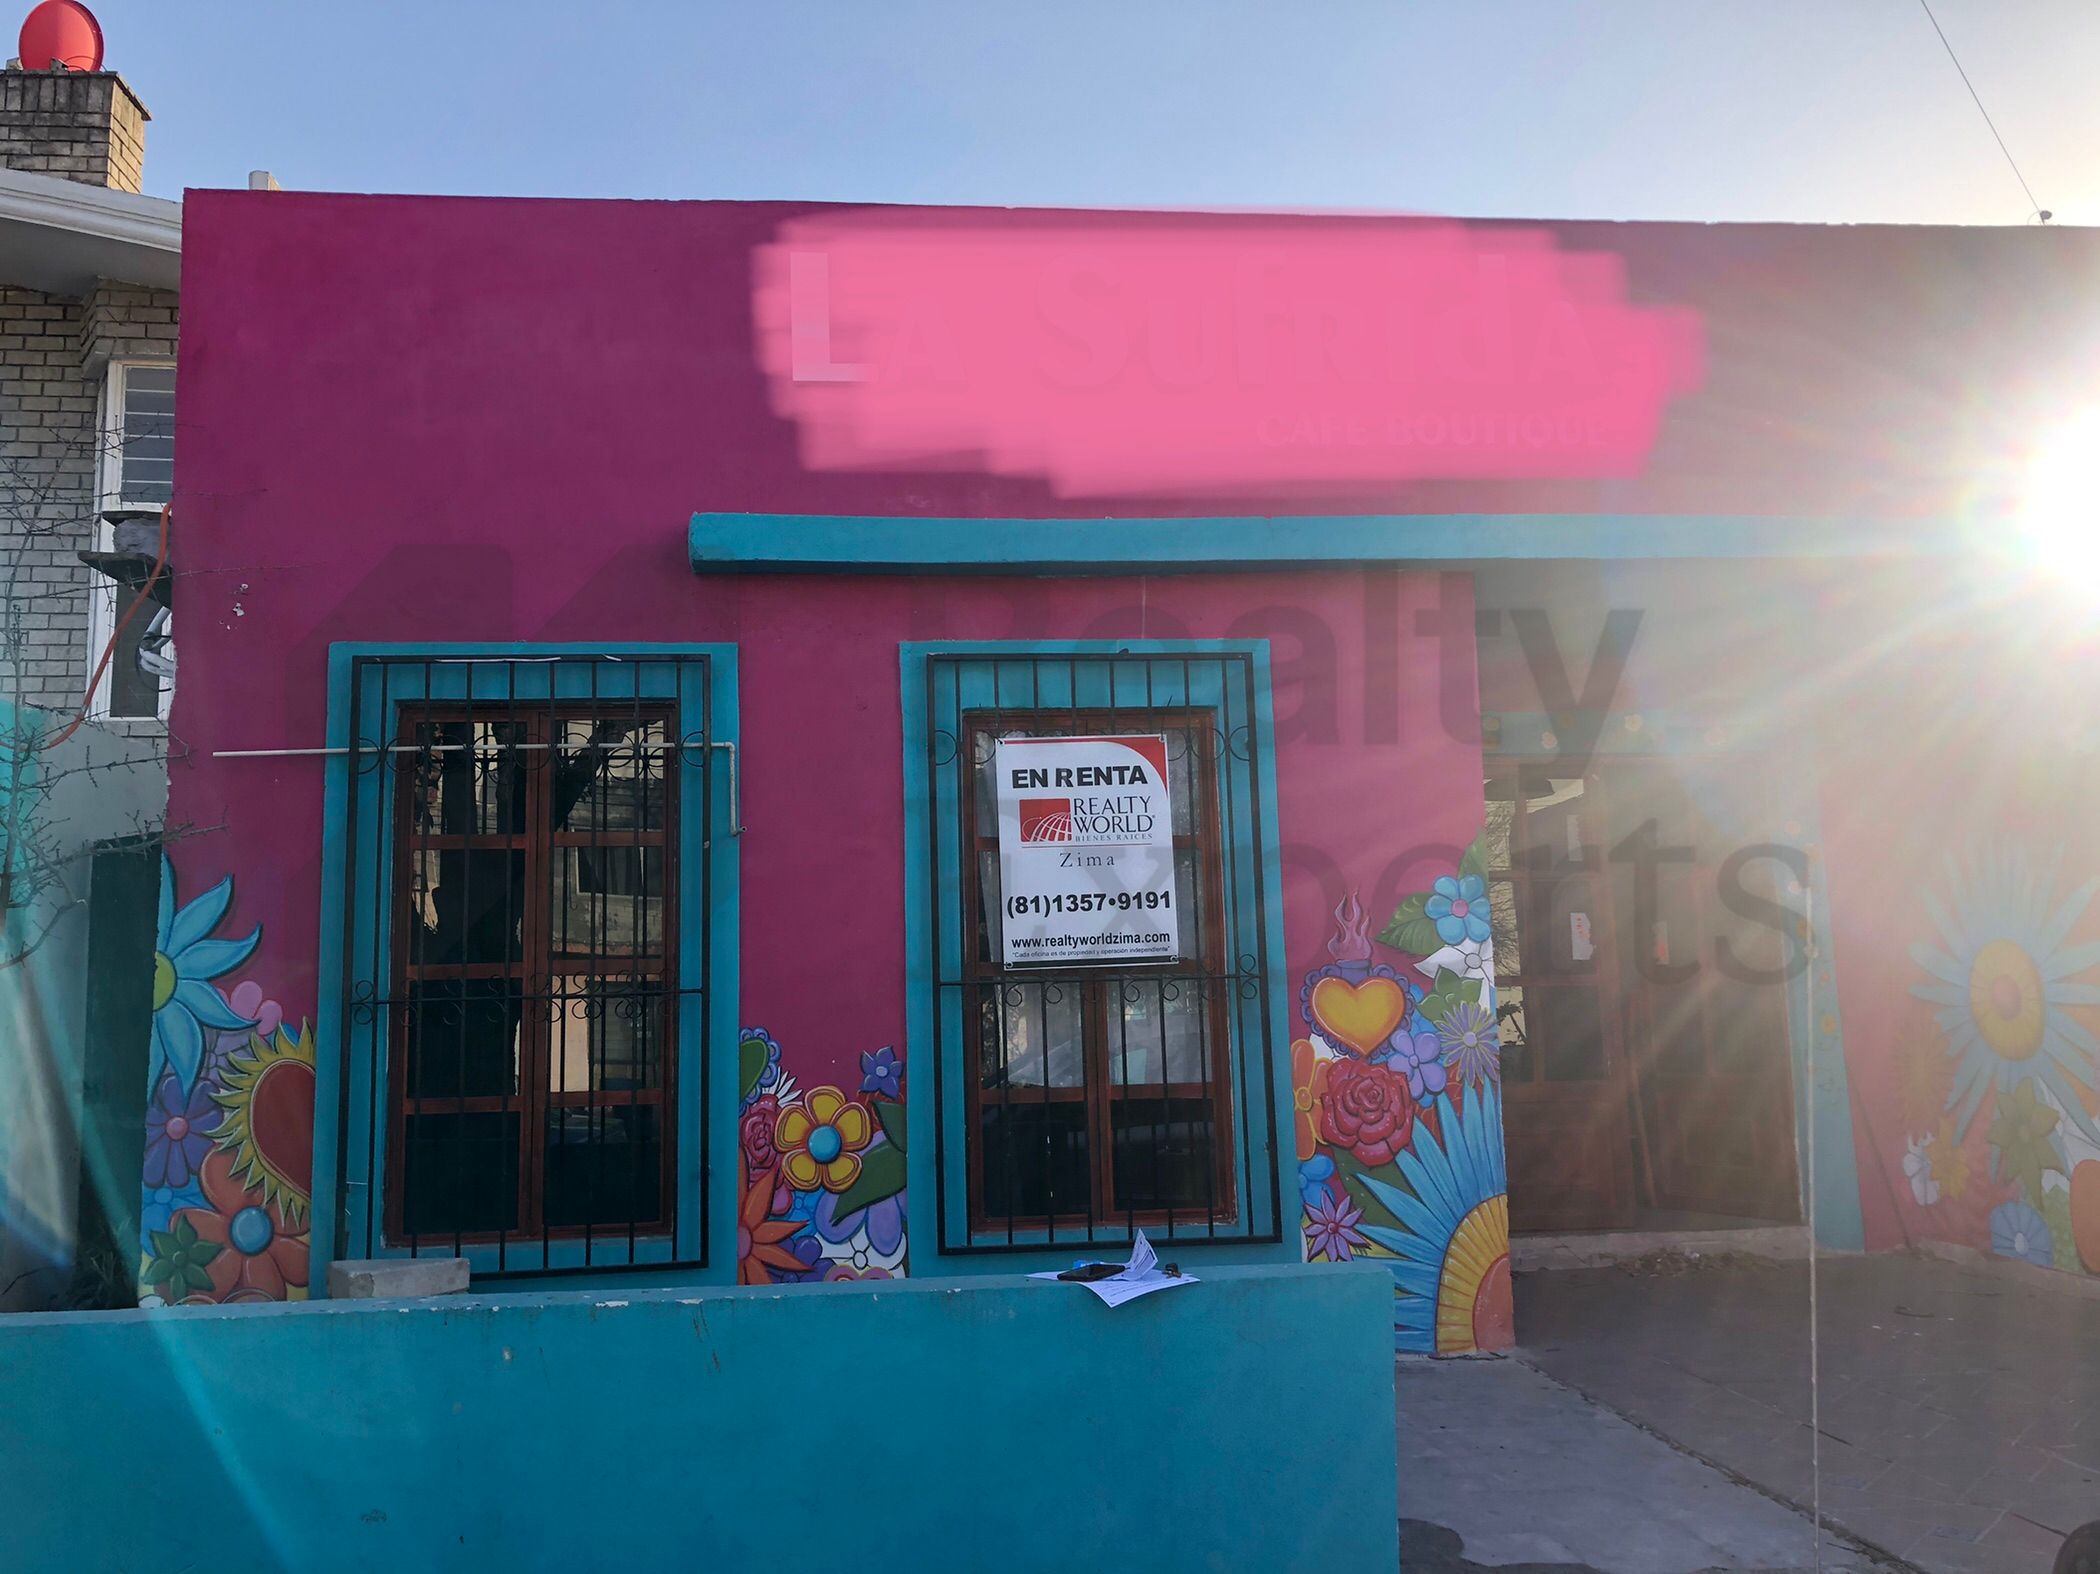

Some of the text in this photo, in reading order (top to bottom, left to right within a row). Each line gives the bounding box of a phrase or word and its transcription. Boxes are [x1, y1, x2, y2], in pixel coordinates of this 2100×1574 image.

[1011, 765, 1148, 788] EN RENTA
[1073, 795, 1151, 815] REALTY
[1073, 815, 1153, 834] WORLD
[1075, 833, 1153, 842] BIENES RAICES
[1059, 852, 1115, 868] Zima
[1011, 931, 1170, 950] www.realtyworldzima.com
